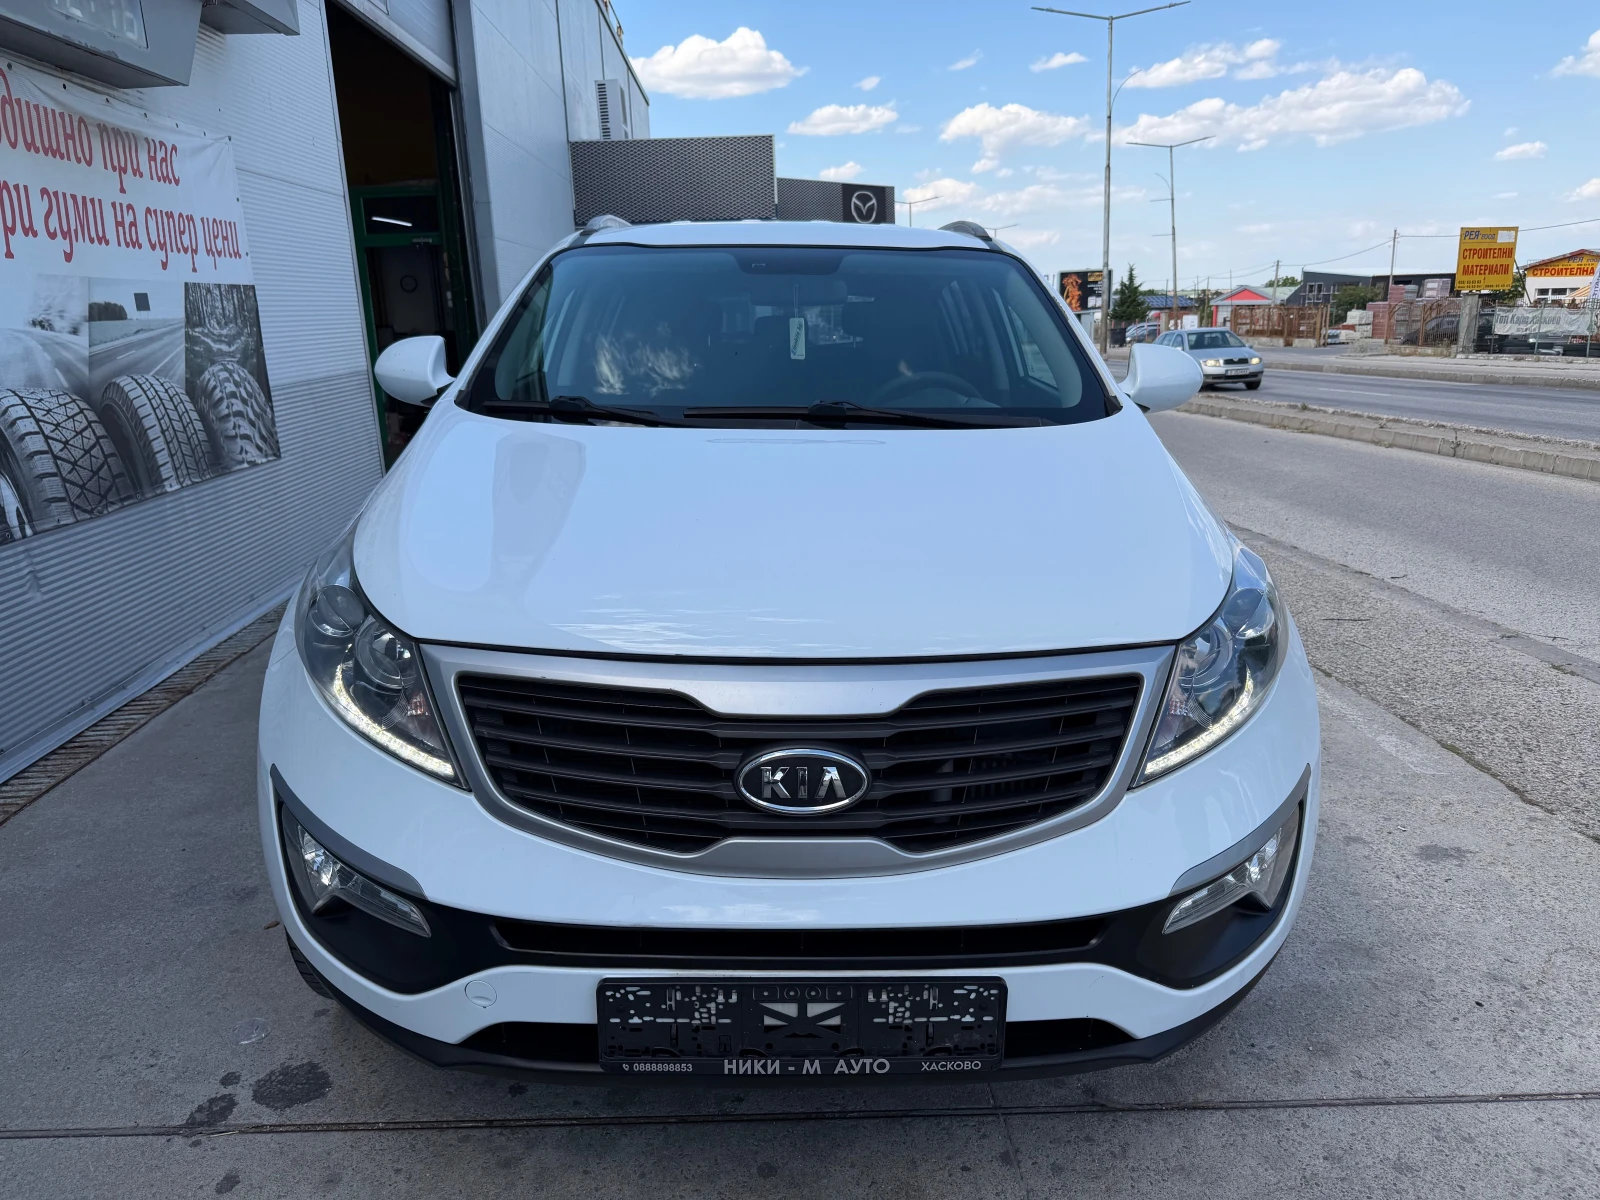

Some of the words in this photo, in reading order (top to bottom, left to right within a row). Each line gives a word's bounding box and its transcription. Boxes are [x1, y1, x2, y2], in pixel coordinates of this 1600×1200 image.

[0, 68, 93, 167] дишно
[97, 122, 143, 194] при
[144, 136, 180, 186] нас
[0, 179, 38, 259] ри
[40, 187, 110, 263] гуми
[110, 201, 142, 250] на
[144, 206, 198, 273] супер
[200, 216, 242, 270] цени
[1462, 247, 1513, 260] СТРОИТЕЛНИ
[1462, 263, 1510, 276] МАТЕРИАЛИ
[1532, 266, 1595, 277] СТРОИТЕЛНА
[760, 766, 847, 799] KIA
[633, 1063, 693, 1072] 0888898853
[723, 1059, 780, 1075] НИКИ
[834, 1058, 891, 1075] АУТО
[921, 1060, 982, 1072] ХАСКОВО
